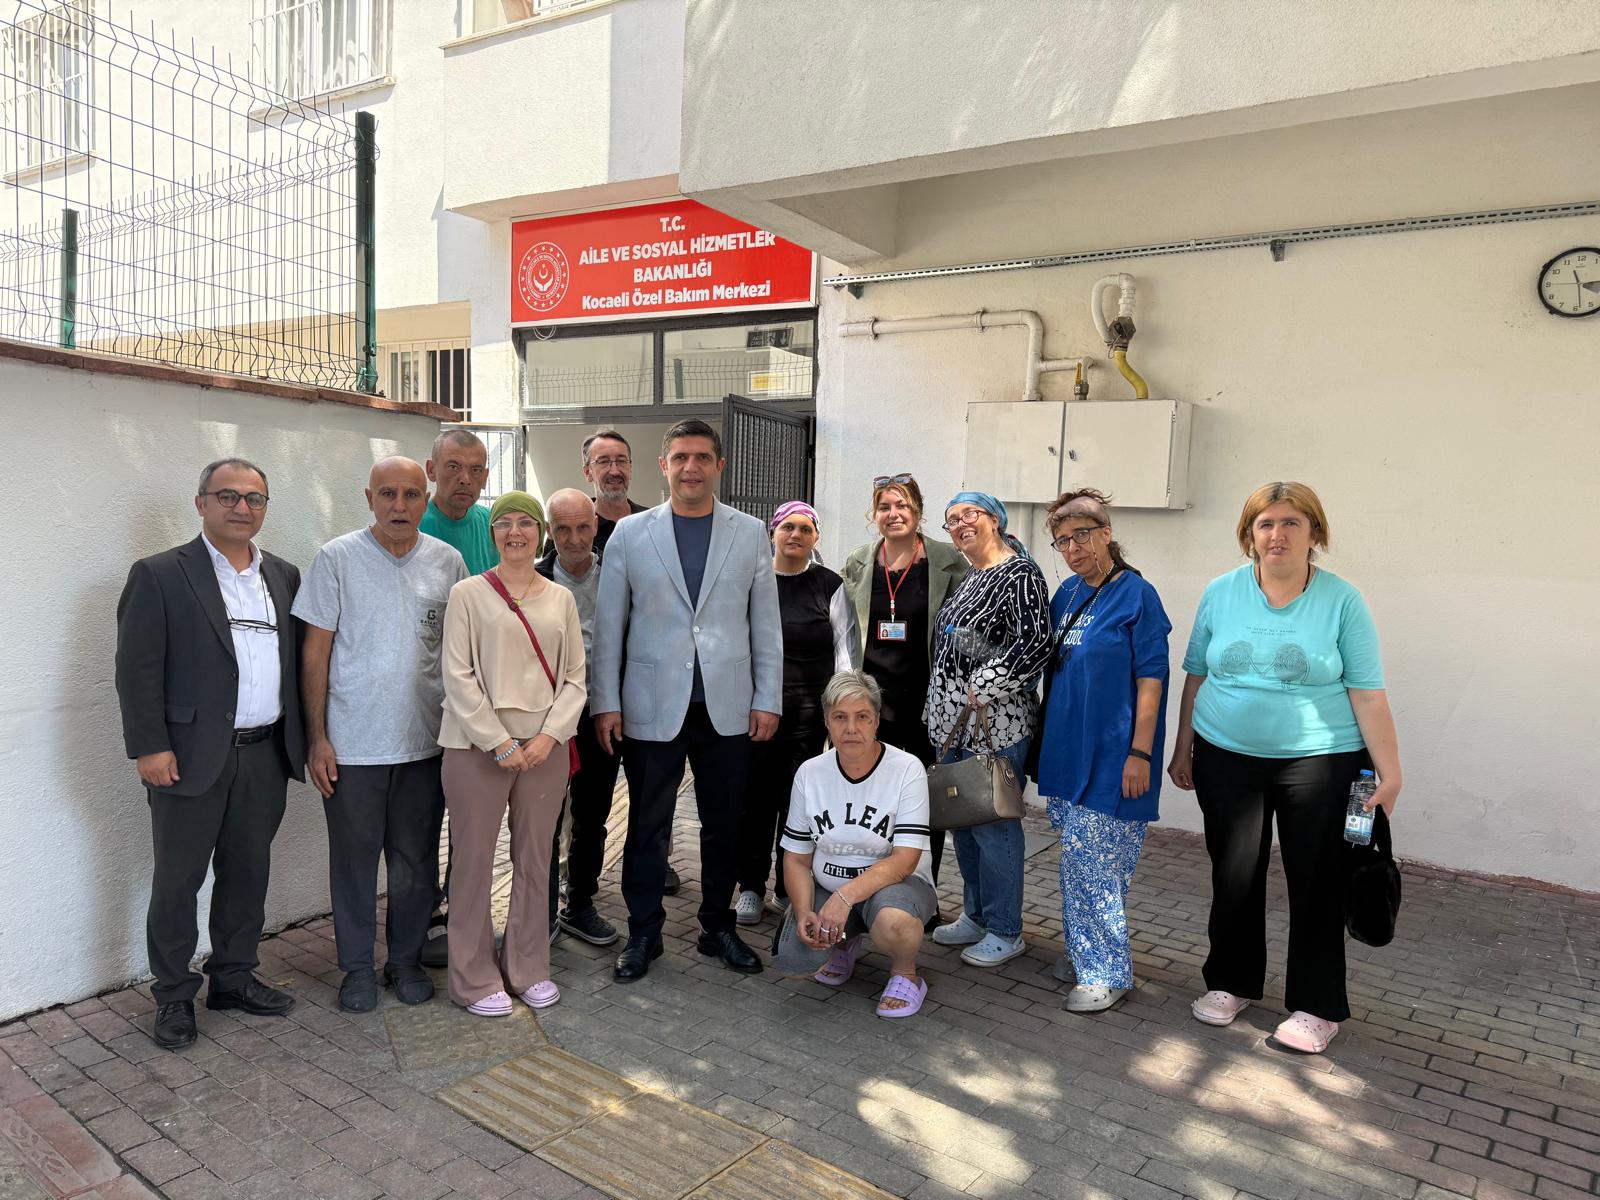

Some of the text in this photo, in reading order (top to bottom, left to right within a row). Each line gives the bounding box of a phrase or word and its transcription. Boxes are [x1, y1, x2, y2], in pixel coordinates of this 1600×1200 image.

[660, 216, 686, 232] T.C.
[579, 231, 776, 265] AİLE VE SOSYAL HİZMETLER
[633, 258, 712, 283] BAKANLIĞI
[582, 280, 771, 310] Kocaeli Özel Bakım Merkezi
[844, 803, 894, 843] LEA
[824, 863, 854, 878] ATHL.
